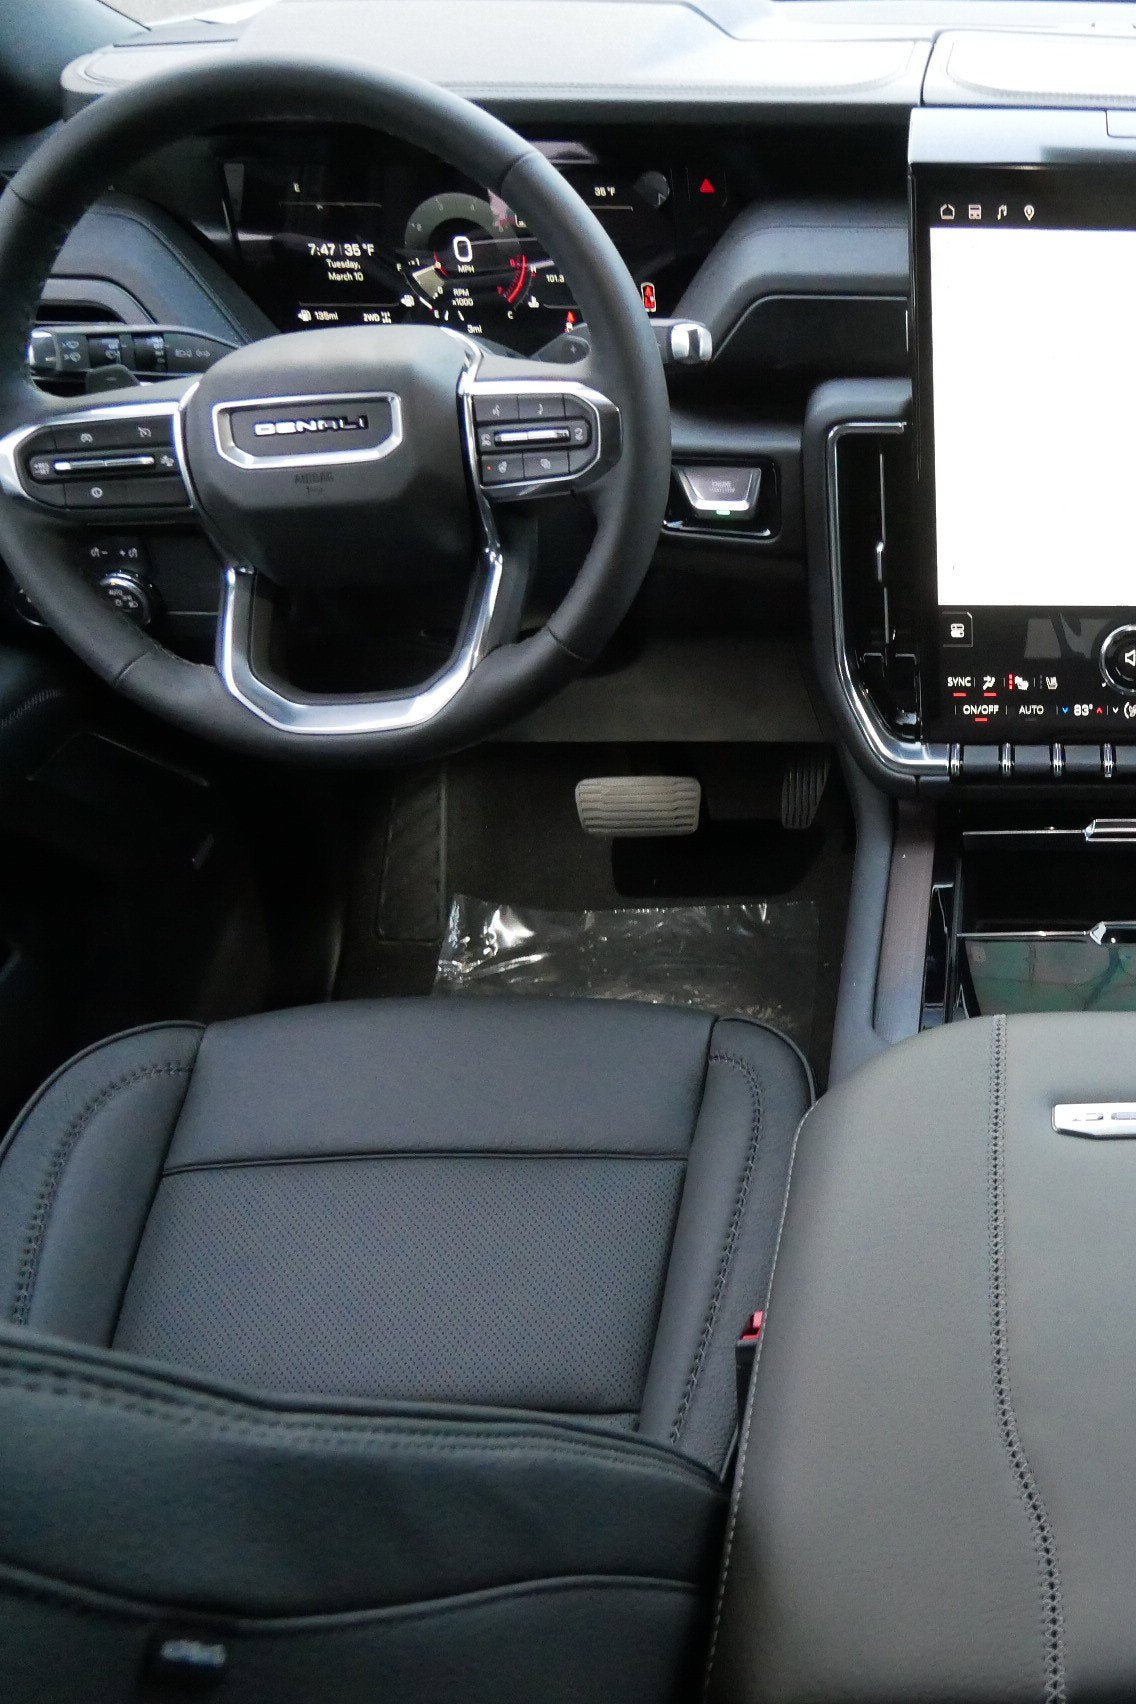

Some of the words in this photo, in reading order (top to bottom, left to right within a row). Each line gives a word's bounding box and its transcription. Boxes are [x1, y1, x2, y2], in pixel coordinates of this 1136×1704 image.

[307, 242, 336, 256] 7:47
[344, 243, 361, 257] 35
[453, 235, 474, 263] 0
[325, 258, 361, 271] Tuesday,
[457, 264, 475, 274] MPH
[327, 271, 353, 281] March
[353, 271, 364, 281] 10
[452, 287, 470, 297] RPM
[254, 414, 369, 436] DENALI
[947, 676, 972, 688] SYNC
[962, 704, 1000, 715] ON/OFF
[1018, 704, 1044, 715] AUTO
